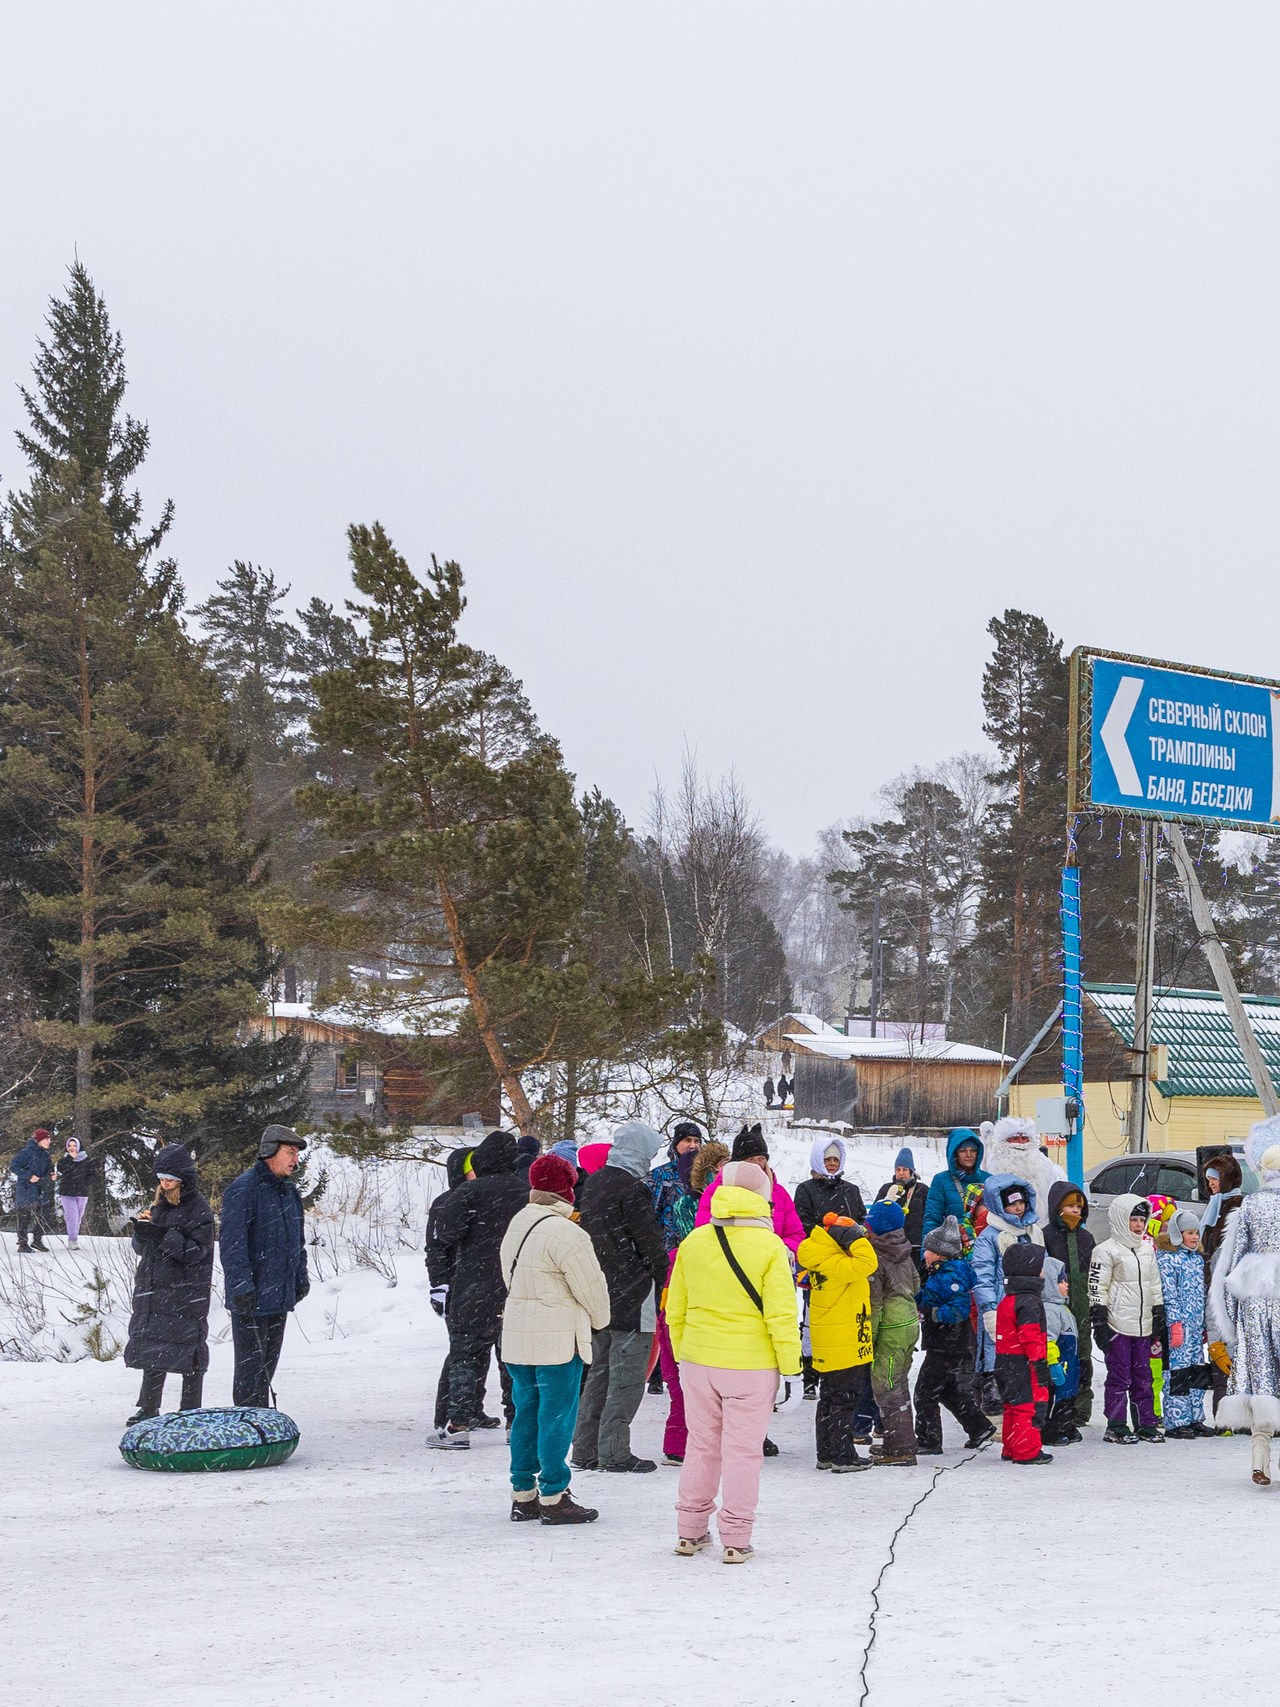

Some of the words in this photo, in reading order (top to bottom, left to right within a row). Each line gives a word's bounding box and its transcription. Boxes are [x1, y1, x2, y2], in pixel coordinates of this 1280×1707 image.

[1149, 697, 1222, 731] СЕВЕРНЫЙ
[1224, 709, 1267, 738] СКЛОН
[1149, 736, 1236, 771] ТРАМПЛИНЫ
[1147, 775, 1188, 806] БАНЯ,
[1191, 781, 1253, 812] БЕСЕДКИ
